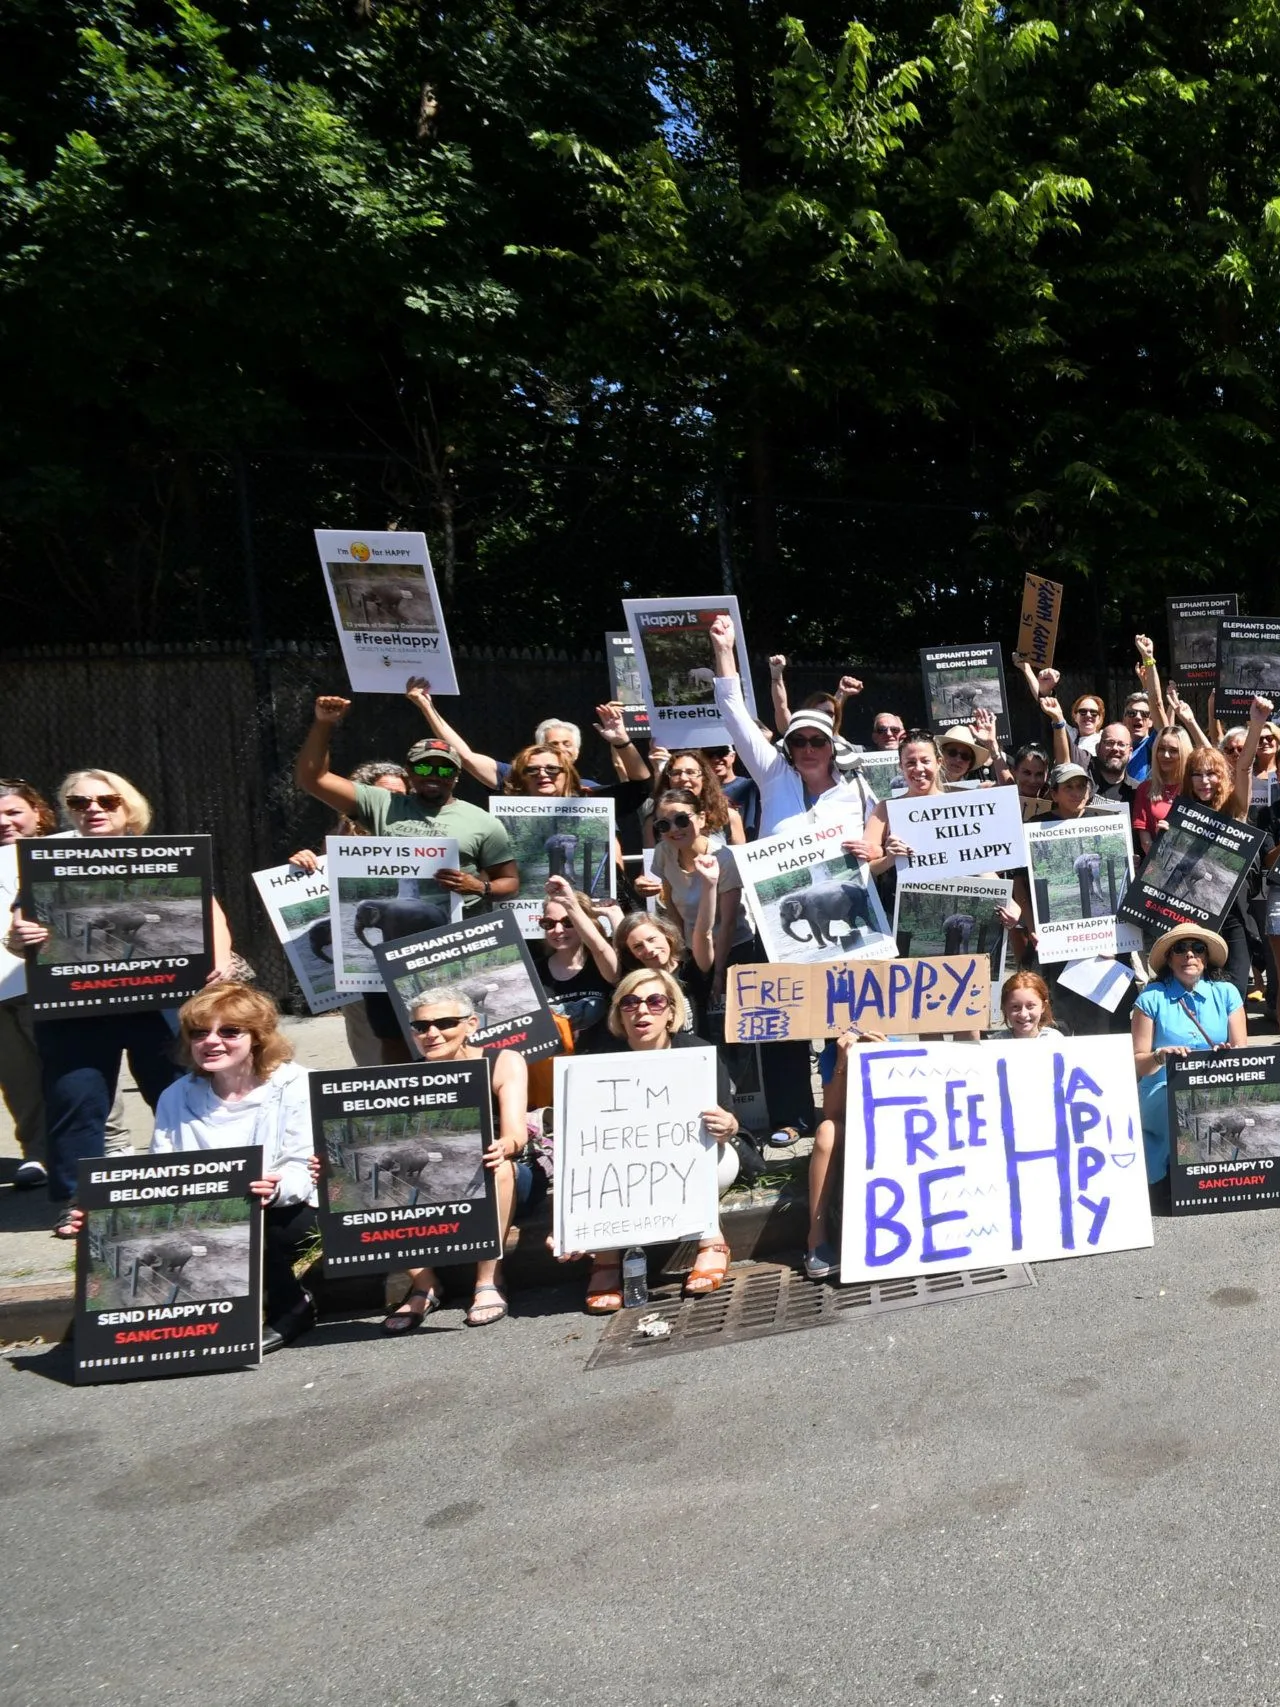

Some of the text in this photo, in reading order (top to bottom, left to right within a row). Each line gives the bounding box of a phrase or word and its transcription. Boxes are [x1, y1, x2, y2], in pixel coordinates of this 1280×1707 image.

[640, 612, 697, 628] Happy is
[354, 633, 439, 648] #FreeHappy
[1031, 623, 1050, 664] HAPPY
[936, 660, 967, 669] BELONG
[495, 805, 609, 814] INNOCENT PRISONER
[908, 802, 997, 823] CAPTIVITY
[935, 822, 982, 840] KILLS
[1029, 823, 1124, 839] INNOCENT PRISONER
[1177, 804, 1255, 843] ELEPHANTS DON'T
[747, 825, 844, 862] HAPPY IS NOT
[1180, 819, 1241, 851] BELONG HERE
[31, 846, 195, 860] ELEPHANTS DON'T
[339, 846, 447, 858] HAPPY IS NOT
[777, 849, 826, 872] HAPPY
[907, 842, 1013, 869] FREE HAPPY
[54, 863, 179, 876] BELONG HERE
[367, 865, 420, 875] HAPPY
[385, 919, 505, 961] ELEPHANTS DON'T
[406, 936, 499, 971] BELONG HERE
[51, 957, 189, 976] SEND HAPPY TO
[69, 973, 177, 991] SANCTUARY
[737, 970, 804, 1007] FREE
[826, 958, 976, 1023] HAPPY
[749, 1015, 780, 1039] BE
[1175, 1054, 1276, 1072] ELEPHANTS DON'T
[322, 1072, 472, 1095] ELEPHANTS DON'T
[1188, 1071, 1266, 1086] BELONG HERE
[343, 1092, 458, 1112] BELONG HERE
[596, 1078, 670, 1113] I'M
[860, 1048, 988, 1169] FREE
[581, 1121, 701, 1156] HERE FOR
[997, 1053, 1110, 1250] HAPPY
[90, 1159, 247, 1184] ELEPHANTS DON'T
[1186, 1159, 1274, 1176] SEND HAPPY TO
[110, 1181, 229, 1202] BELONG HERE
[569, 1157, 697, 1214] HAPPY
[1198, 1174, 1266, 1189] SANCTUARY
[342, 1203, 472, 1226] SEND HAPPY TO
[864, 1165, 972, 1268] BE
[360, 1223, 460, 1243] SANCTUARY
[97, 1301, 233, 1326] SEND HAPPY TO
[115, 1323, 220, 1345] SANCTUARY
